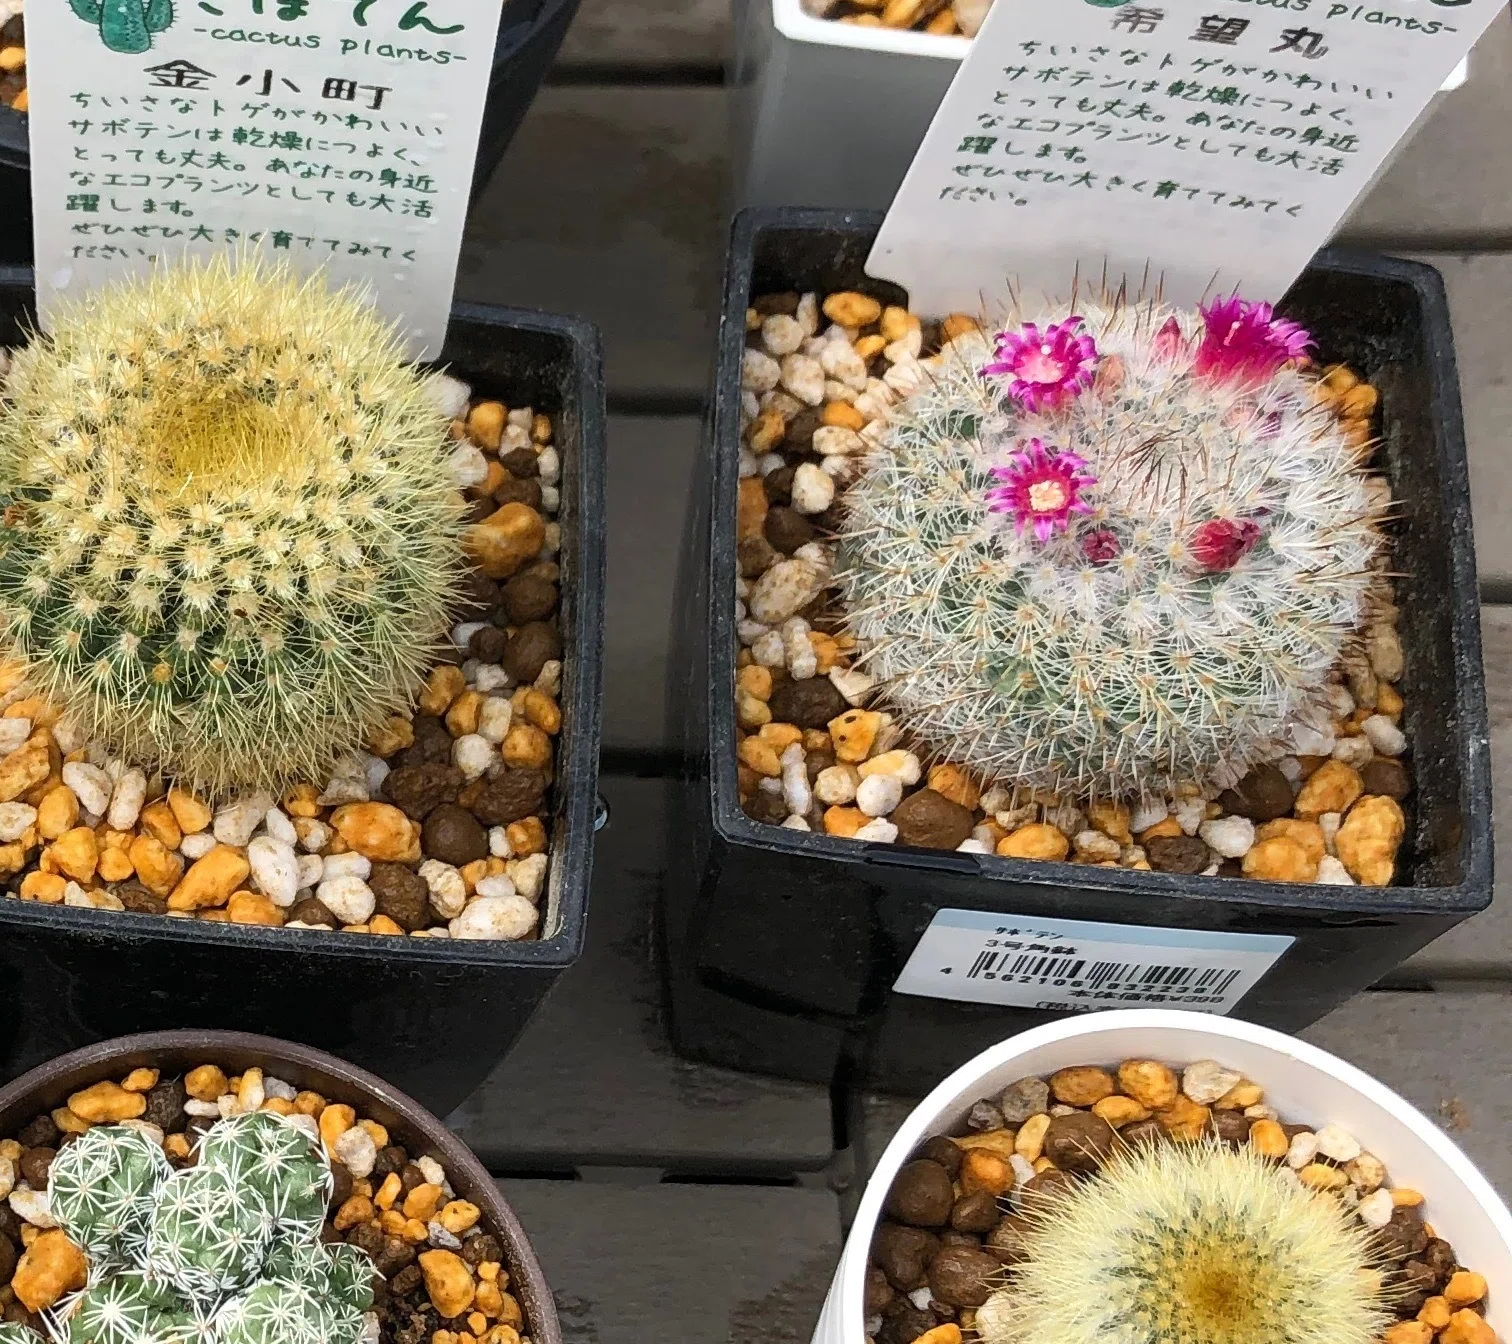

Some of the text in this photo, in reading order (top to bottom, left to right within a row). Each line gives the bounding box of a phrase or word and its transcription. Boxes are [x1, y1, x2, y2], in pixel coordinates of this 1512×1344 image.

[1111, 8, 1330, 59] 希望丸
[142, 59, 394, 111] 金小町
[1018, 40, 1393, 100] ちいさなトゲがかわいい
[69, 91, 443, 137] ちいさなトゲがかわいい
[976, 113, 1346, 176] なエコプランツとしても大活
[68, 170, 434, 219] なエコプランツとしても大活
[985, 939, 1078, 956] 3号角鉢
[940, 967, 1208, 994] 4 562106 832238
